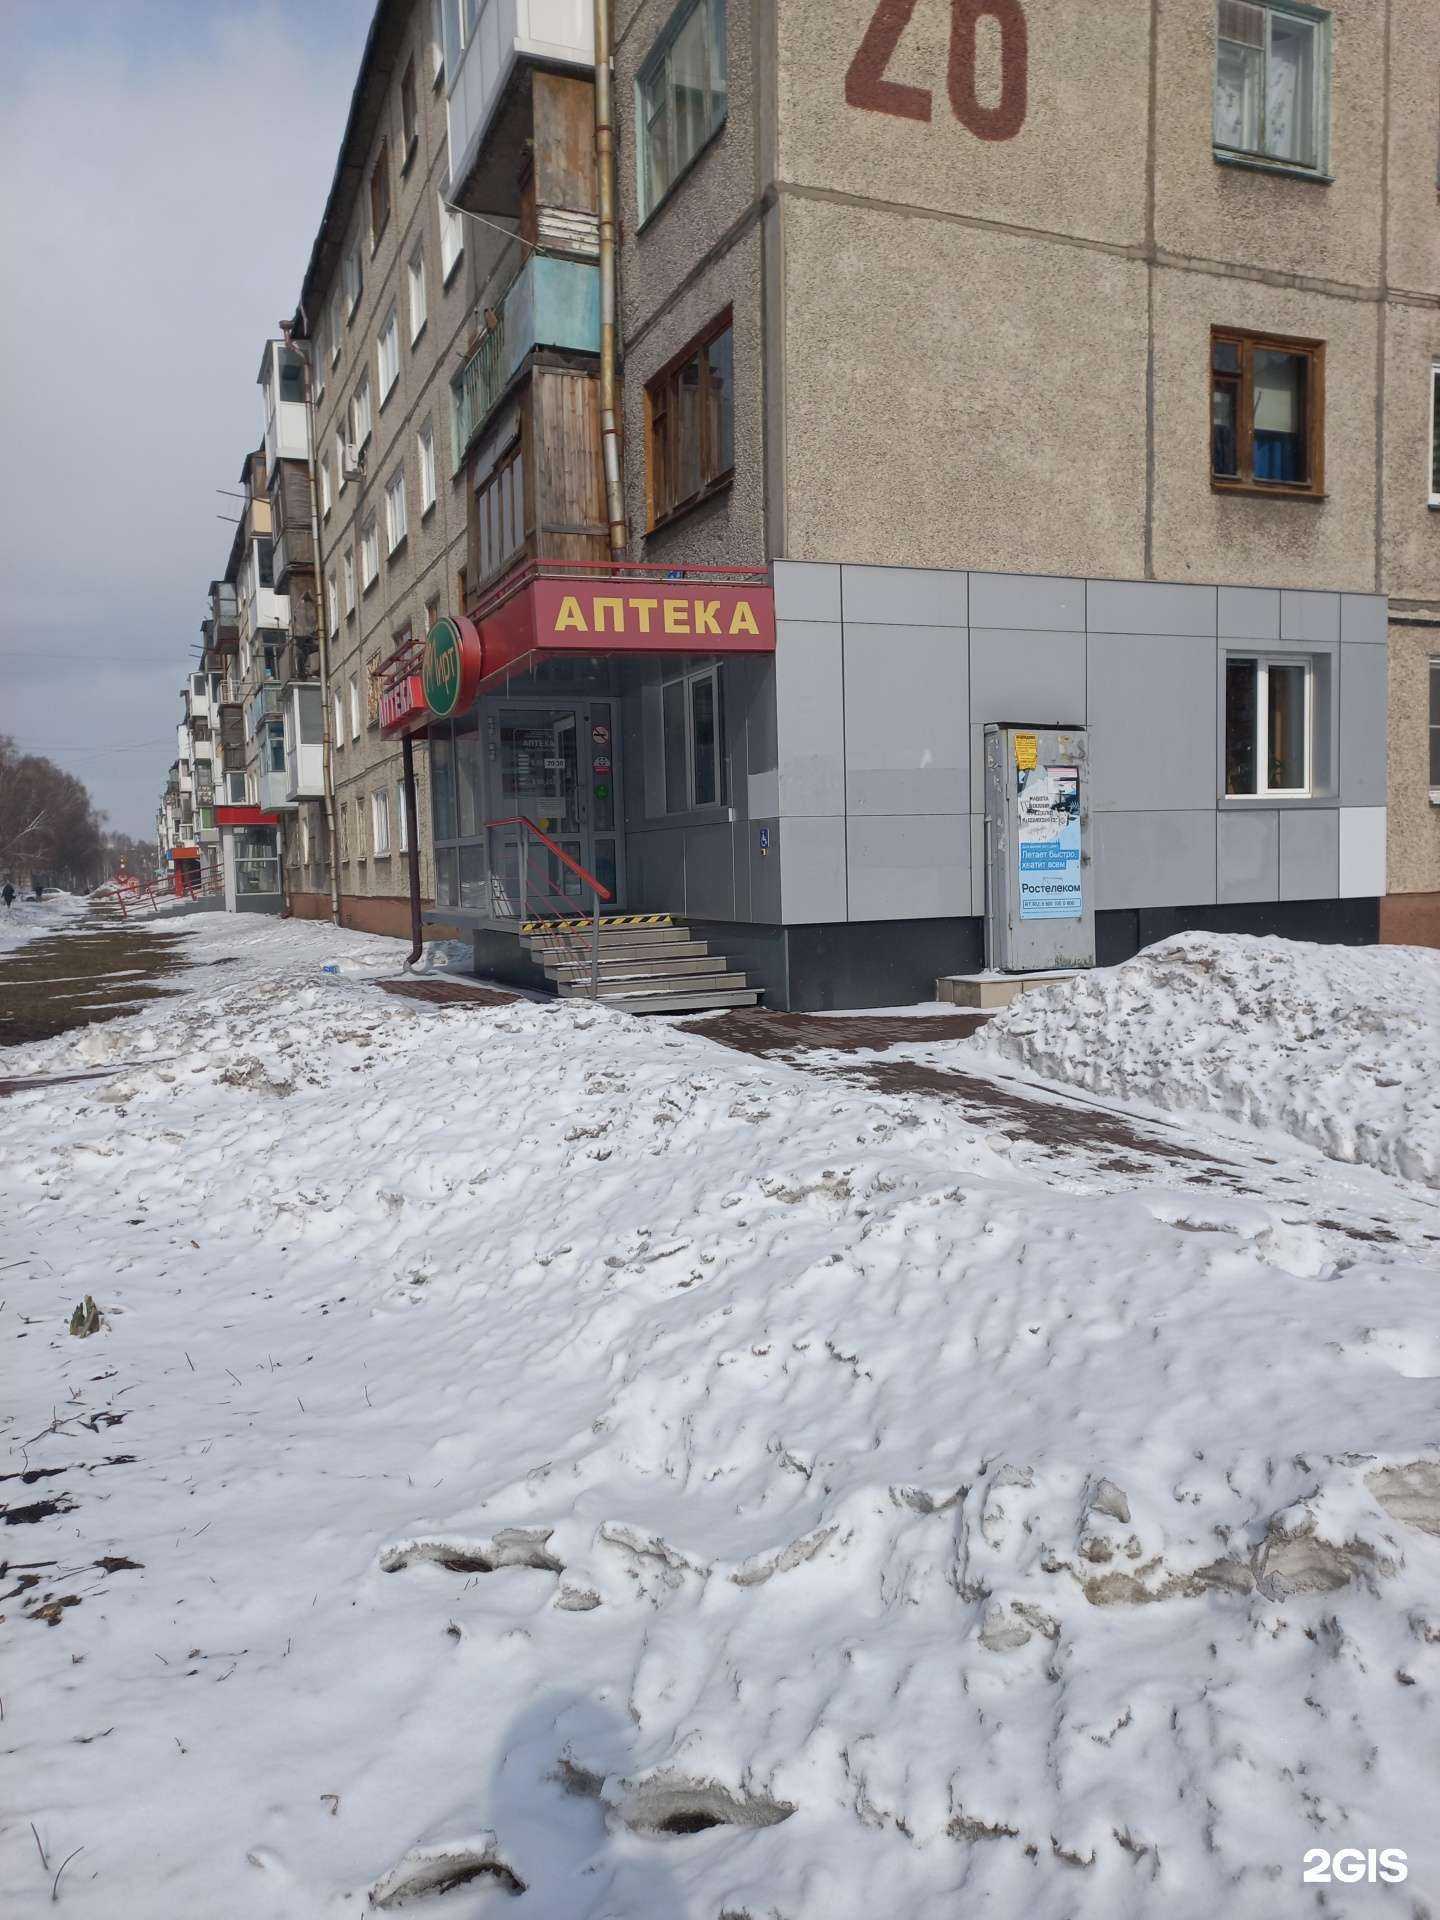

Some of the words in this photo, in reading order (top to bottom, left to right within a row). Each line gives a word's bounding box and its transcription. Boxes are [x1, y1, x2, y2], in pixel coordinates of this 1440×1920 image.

[845, 0, 1028, 141] 20
[554, 596, 760, 635] АПТЕКА
[1022, 883, 1080, 894] Ростелеком
